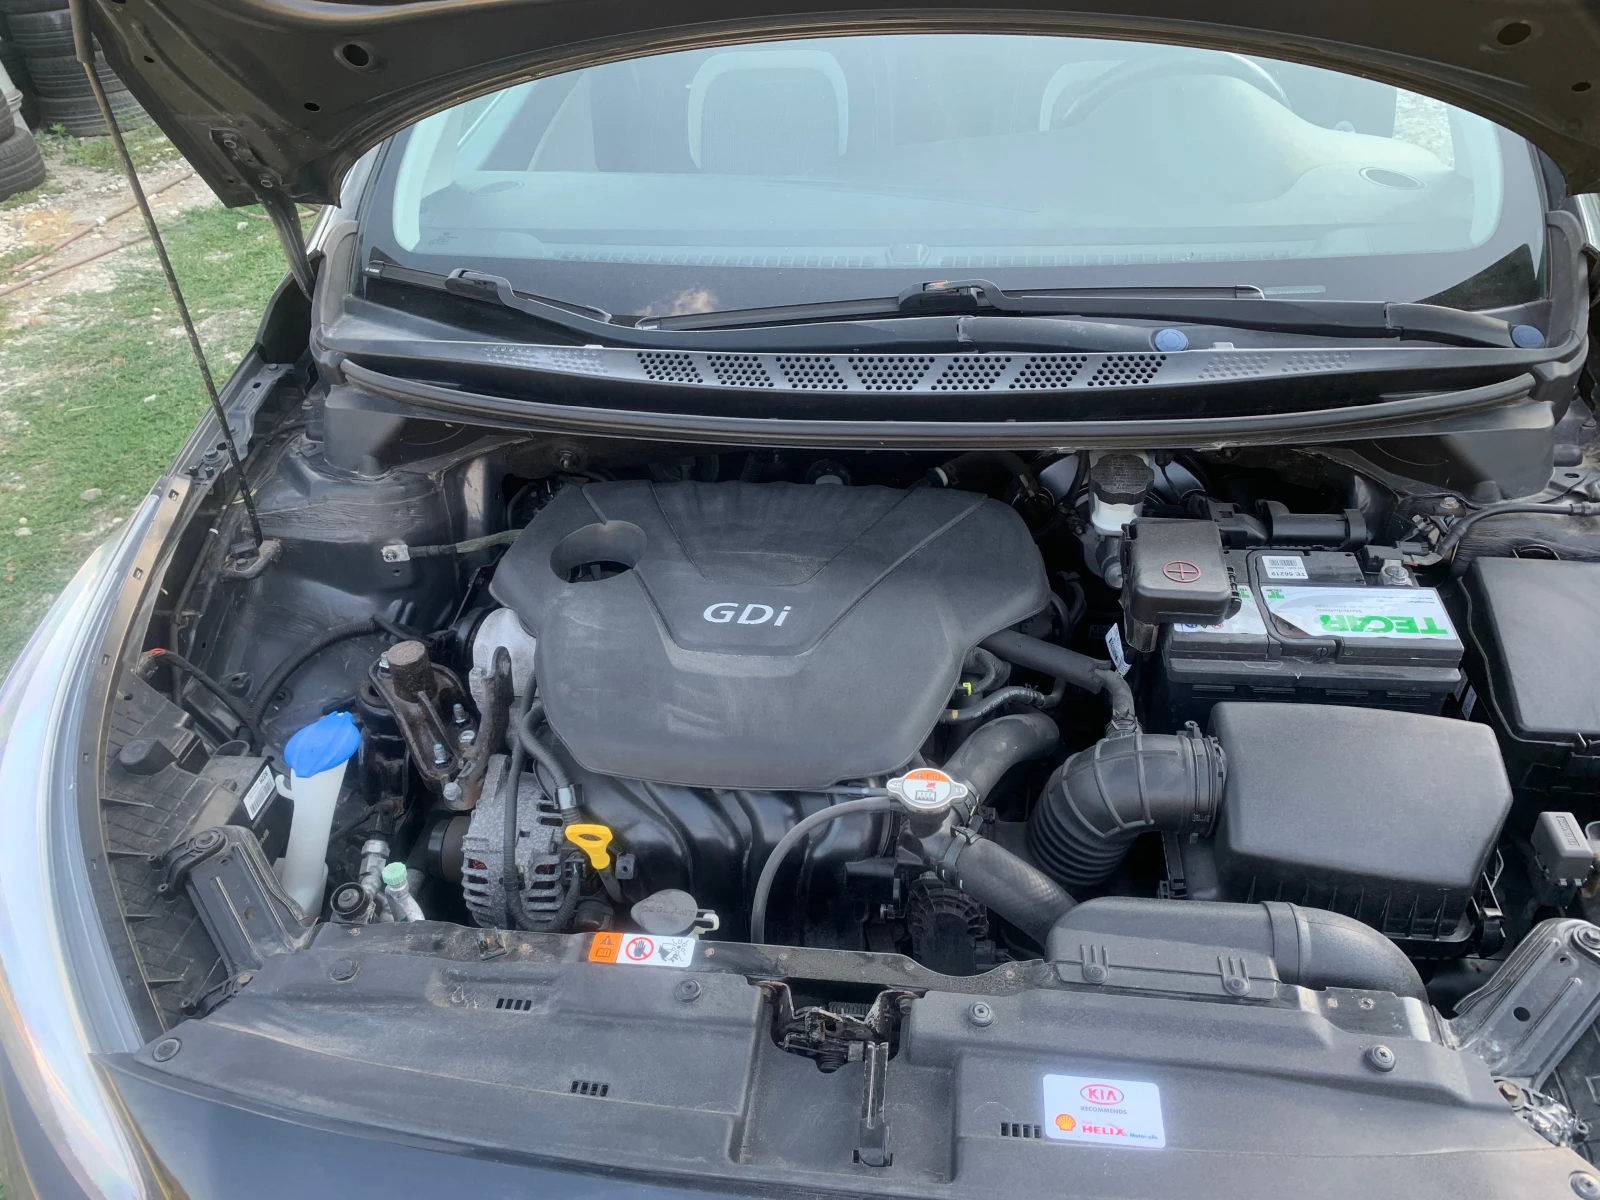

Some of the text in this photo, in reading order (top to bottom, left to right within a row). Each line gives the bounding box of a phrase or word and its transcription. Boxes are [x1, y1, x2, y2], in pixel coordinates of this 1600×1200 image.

[703, 602, 792, 627] GDi
[1317, 614, 1449, 634] TECAR
[641, 905, 695, 916] COOLANT
[1089, 1088, 1117, 1101] KIA
[1080, 1105, 1128, 1115] RECOMMENDS
[1081, 1125, 1127, 1137] HELIX
